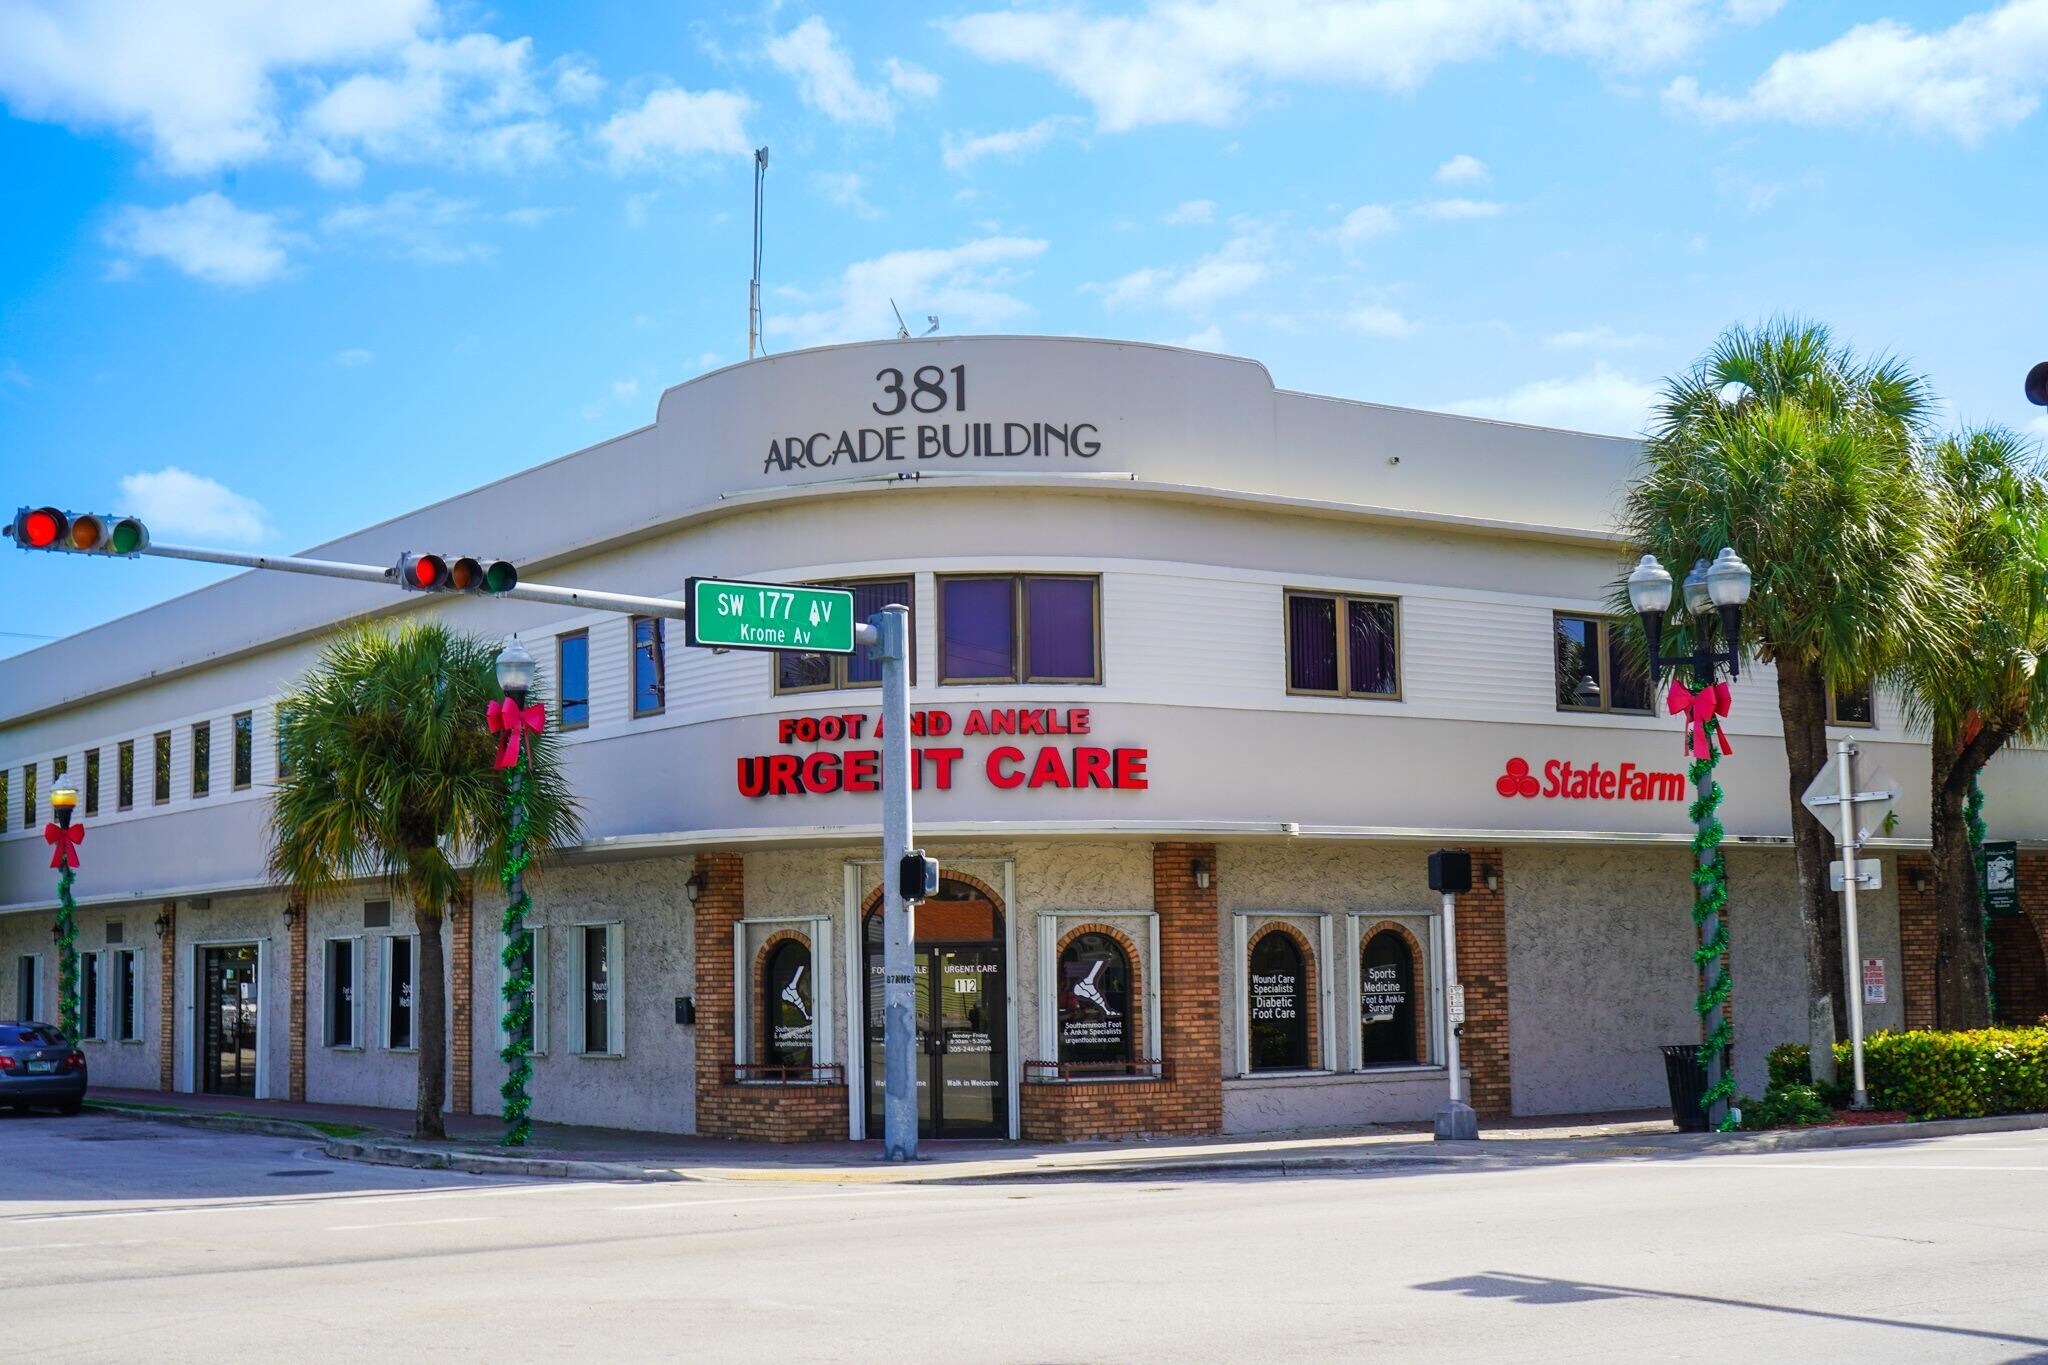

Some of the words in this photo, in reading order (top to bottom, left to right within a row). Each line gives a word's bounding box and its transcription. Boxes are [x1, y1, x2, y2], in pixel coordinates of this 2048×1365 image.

[872, 364, 965, 416] 381
[763, 426, 906, 474] ARCADE
[918, 422, 1101, 459] BUILDING
[717, 593, 744, 617] SW
[758, 591, 795, 619] 177
[809, 600, 833, 624] AV
[740, 624, 785, 643] Krome
[794, 627, 811, 645] Av
[778, 713, 867, 744] FOOT
[874, 710, 953, 737] ND
[963, 708, 1091, 736] ANKLE
[986, 746, 1149, 791] CARE
[944, 965, 974, 973] URGENT
[976, 964, 998, 973] CARE
[1368, 968, 1396, 980] Sports
[1252, 974, 1276, 984] Wound
[1278, 974, 1295, 984] Care
[957, 979, 976, 992] 112
[1253, 983, 1294, 995] Specialists
[1364, 981, 1400, 992] Medicine
[1256, 996, 1293, 1008] Diabetic
[1361, 996, 1377, 1004] Foot
[1378, 996, 1383, 1004] &
[1385, 995, 1405, 1004] Ankle
[1252, 1008, 1273, 1019] Foot
[1274, 1007, 1296, 1019] Care
[1368, 1004, 1396, 1013] Surgery
[1065, 1021, 1107, 1029] Southernmost
[1089, 1028, 1122, 1036] Specialists
[946, 1079, 961, 1087] Walk
[963, 1079, 970, 1087] in
[970, 1079, 999, 1087] Welcome
